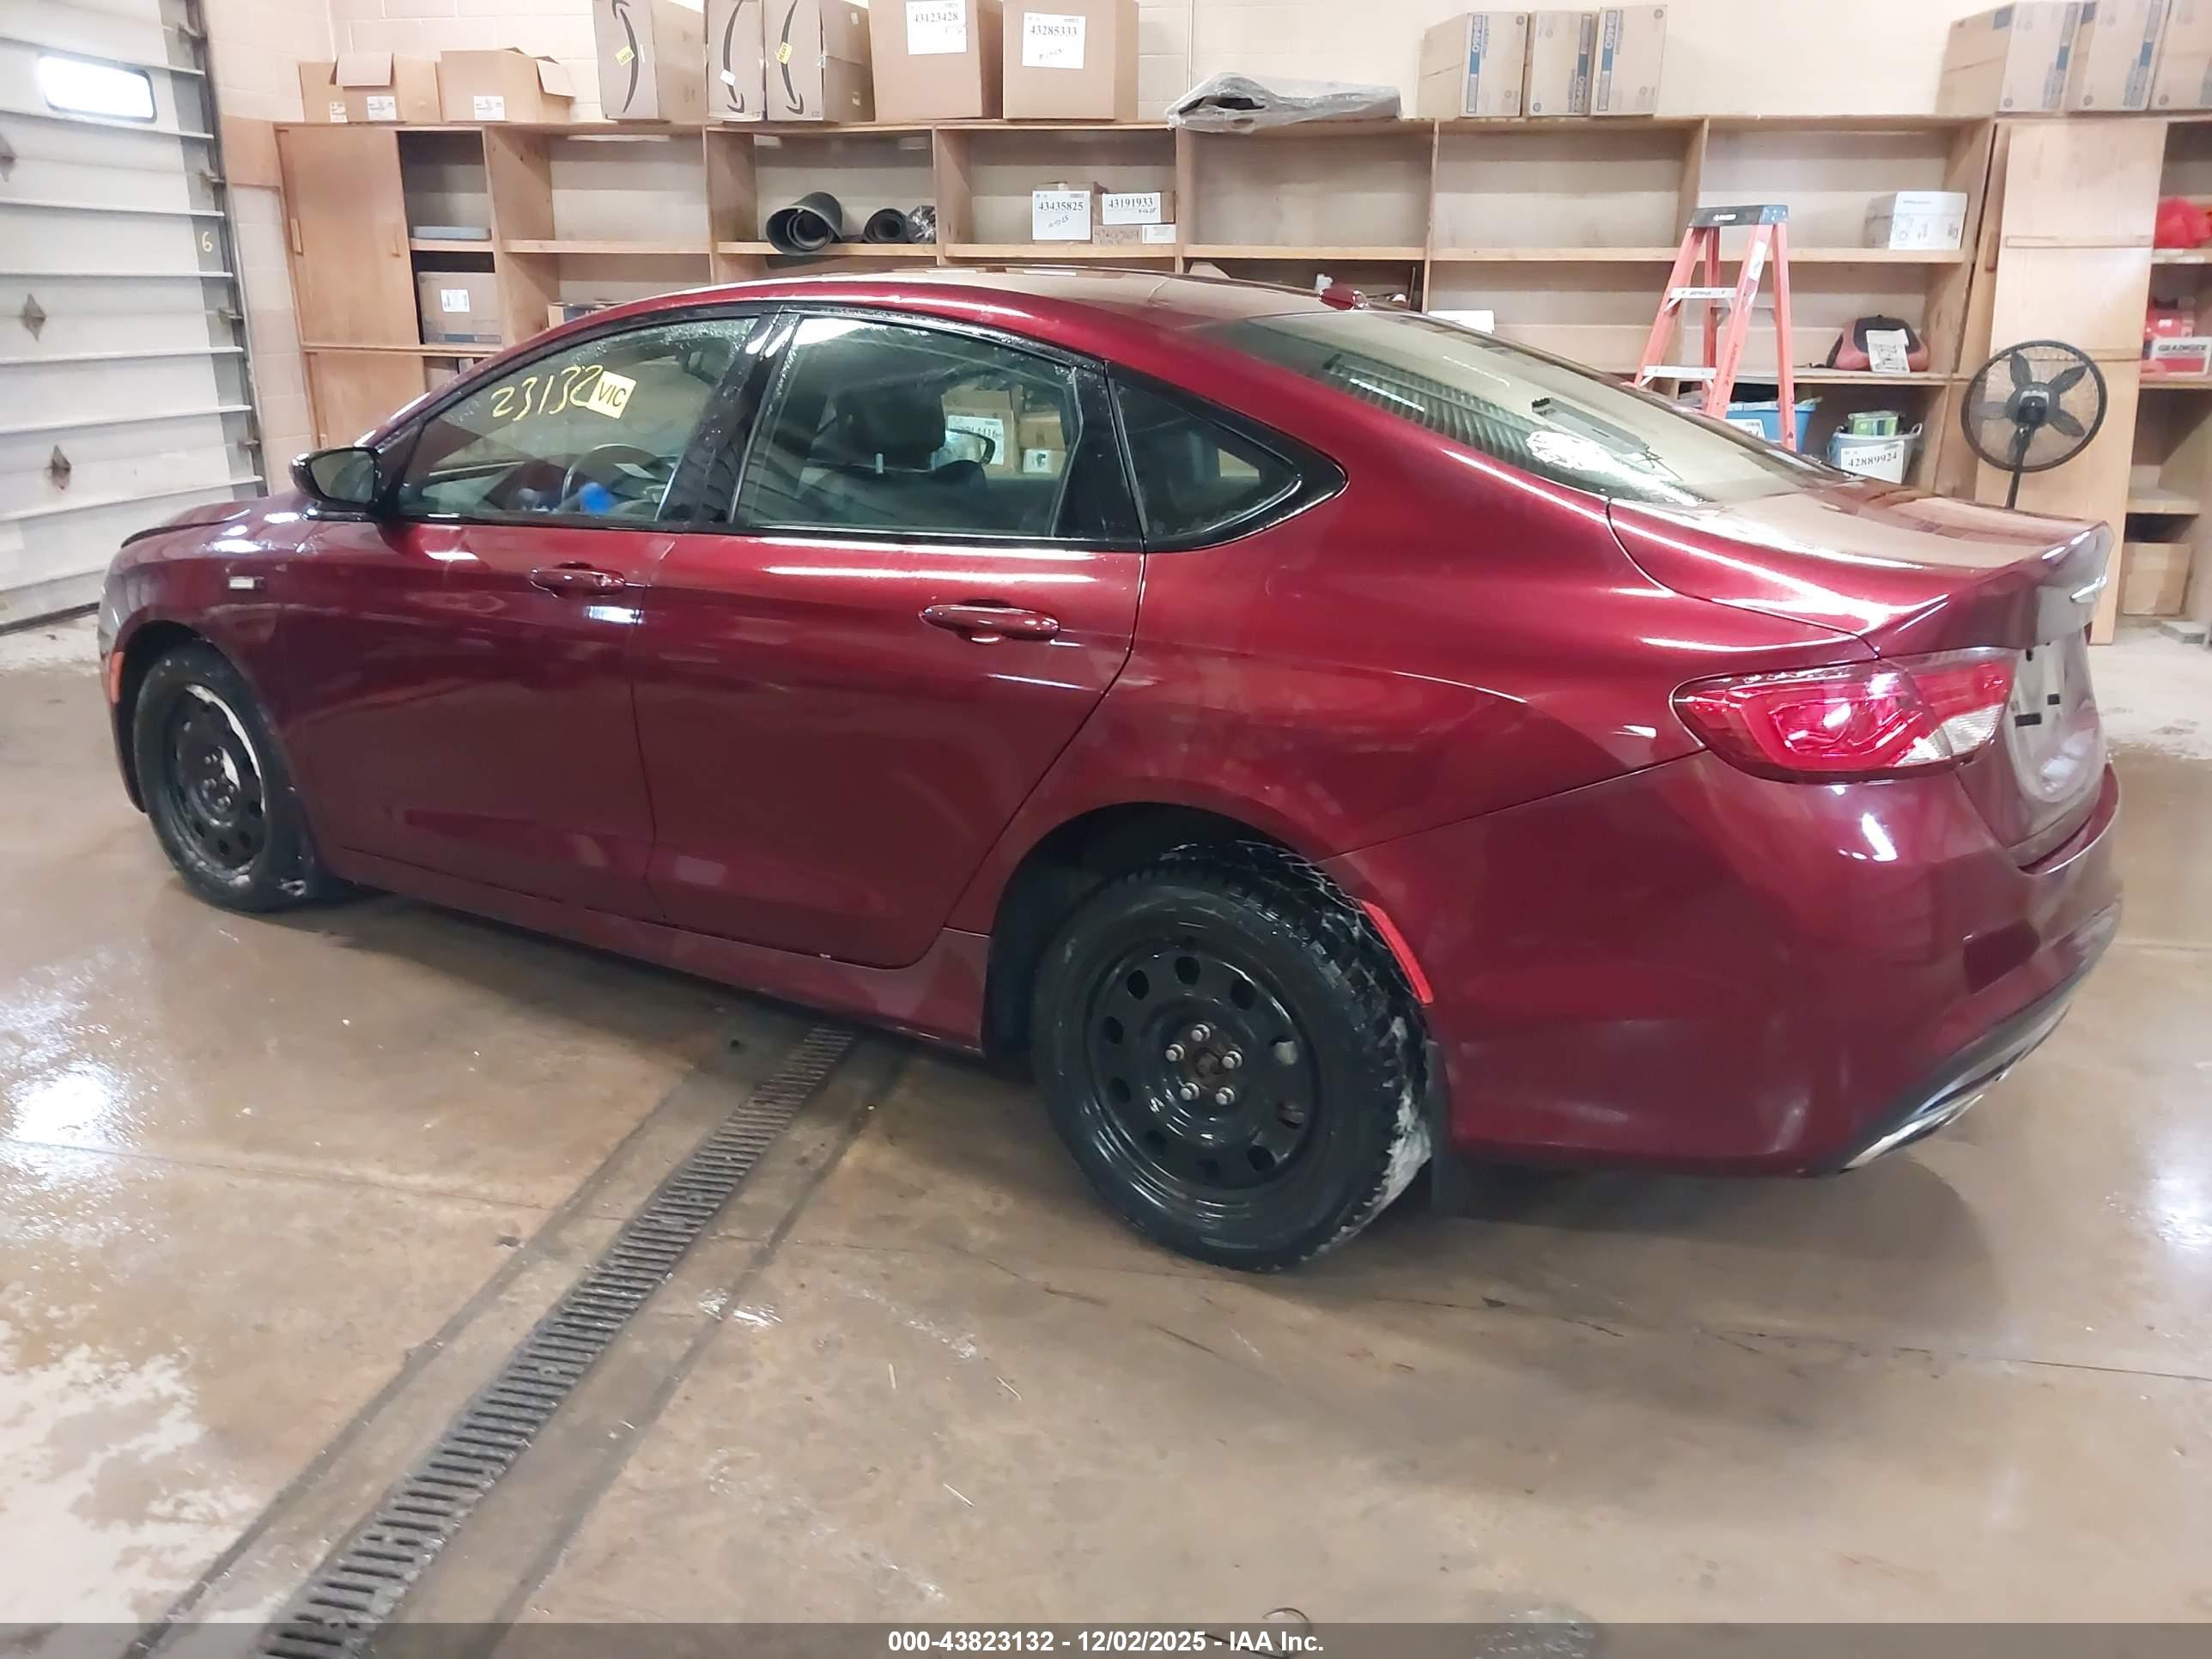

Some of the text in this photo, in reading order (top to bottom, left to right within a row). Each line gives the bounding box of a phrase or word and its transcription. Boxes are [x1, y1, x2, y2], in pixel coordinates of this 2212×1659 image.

[914, 12, 958, 23] 43123428
[1030, 25, 1078, 37] 43285333
[1038, 201, 1084, 211] 43435825
[1108, 197, 1153, 208] 43191933
[202, 231, 213, 252] 6
[491, 364, 604, 422] 23132
[598, 381, 627, 407] VIC
[1848, 452, 1898, 467] 42889924
